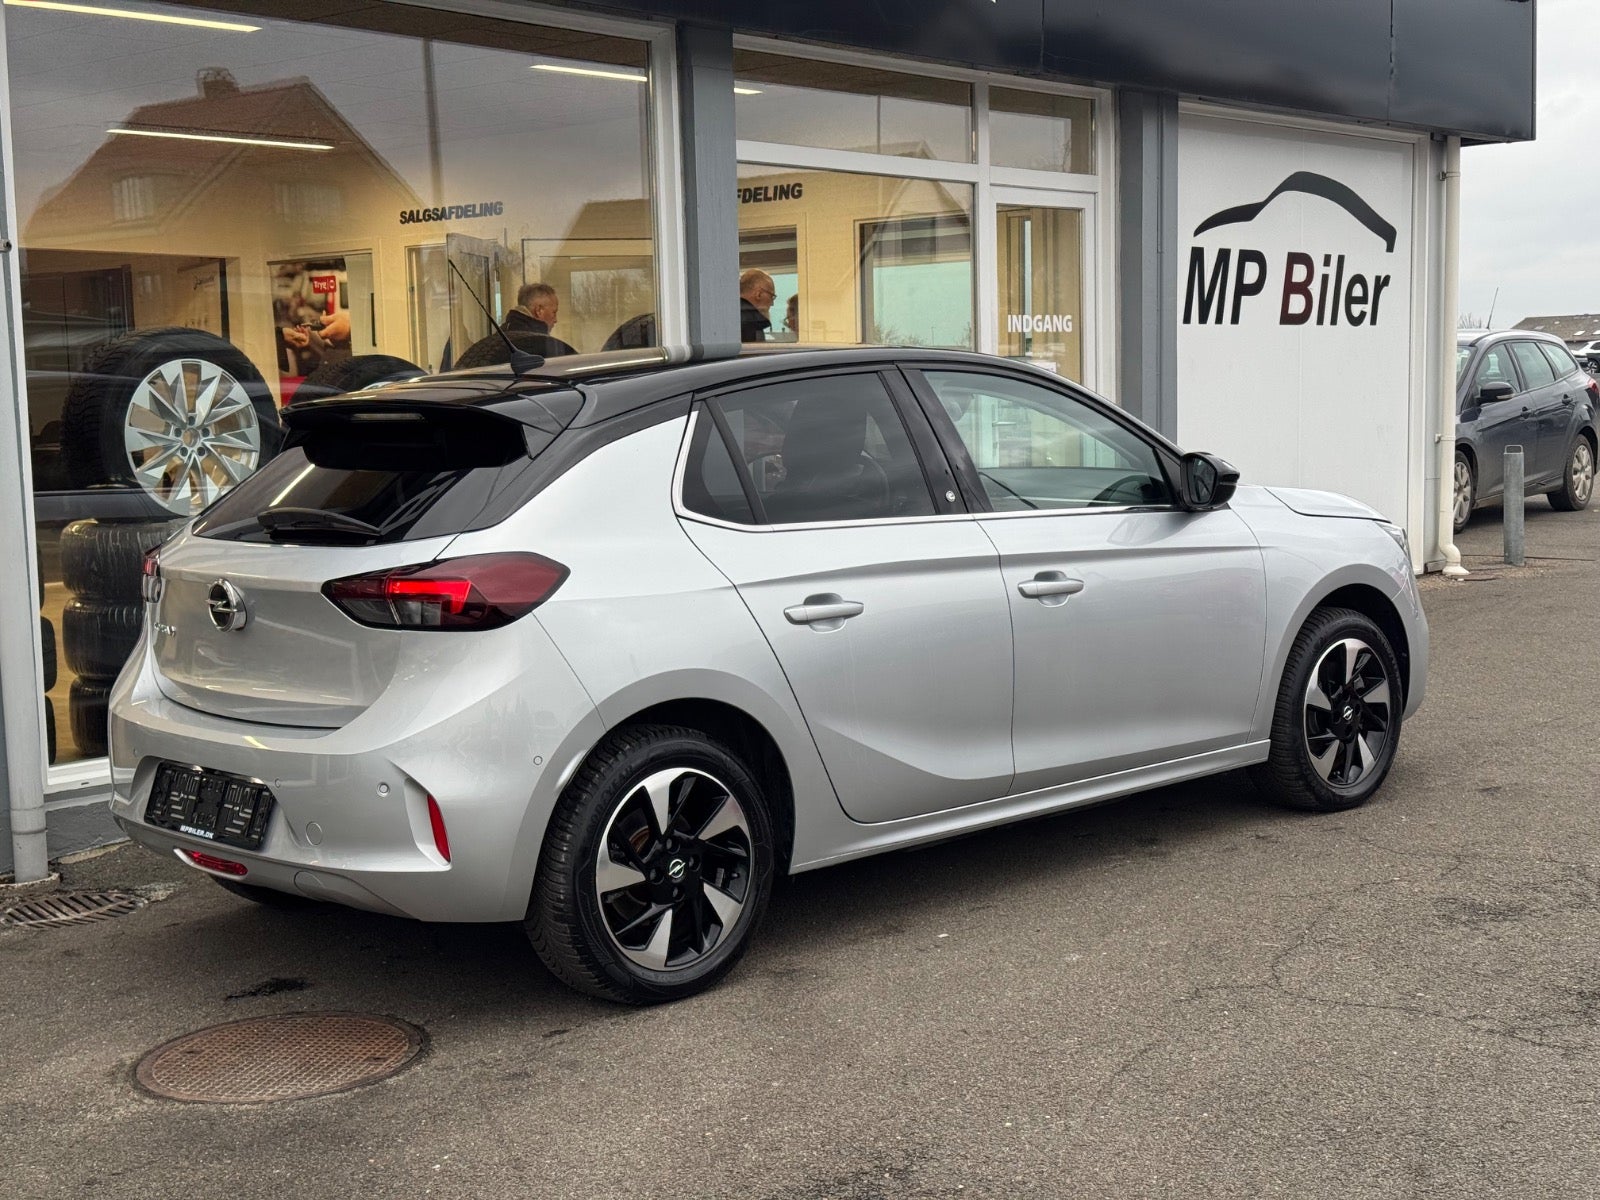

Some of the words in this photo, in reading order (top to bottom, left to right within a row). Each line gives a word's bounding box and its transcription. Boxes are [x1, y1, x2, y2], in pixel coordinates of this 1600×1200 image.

[400, 201, 503, 224] SALGSAFDELING
[1183, 246, 1267, 325] MP
[1279, 252, 1391, 327] Biler
[1007, 314, 1073, 333] INDGANG
